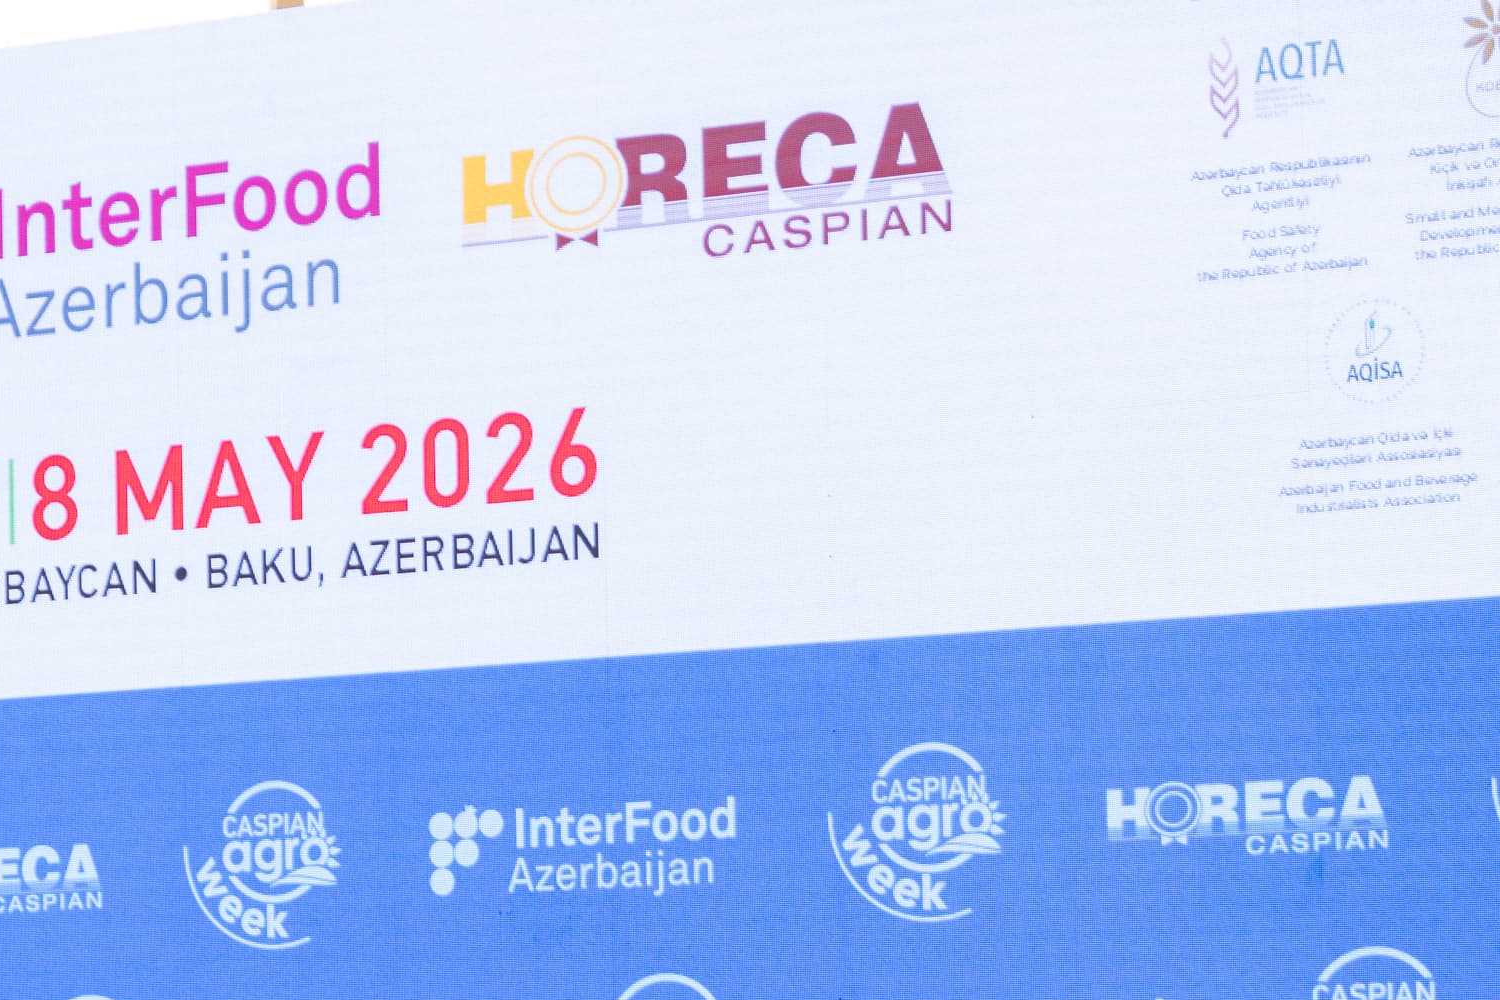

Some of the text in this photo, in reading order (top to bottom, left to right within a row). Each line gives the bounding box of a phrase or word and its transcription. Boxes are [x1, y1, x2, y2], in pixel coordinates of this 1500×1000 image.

[1255, 39, 1345, 82] AQTA
[462, 101, 947, 233] HORECA
[702, 199, 952, 258] CASPIAN
[1347, 358, 1403, 382] AQİSA
[114, 432, 326, 536] MAY
[361, 406, 598, 516] 2026
[207, 545, 324, 590] BAKU,
[340, 522, 601, 579] AZERBAIJAN
[871, 774, 985, 805] CASPIAN
[1106, 775, 1387, 841] HORECA
[223, 811, 324, 839] CASPIAN
[514, 797, 736, 849] InterFood
[871, 798, 993, 850] agro
[1245, 829, 1389, 855] CASPIAN
[222, 835, 329, 882] agro
[508, 851, 714, 896] Azerbaijan
[842, 824, 947, 911] week
[196, 858, 289, 939] week
